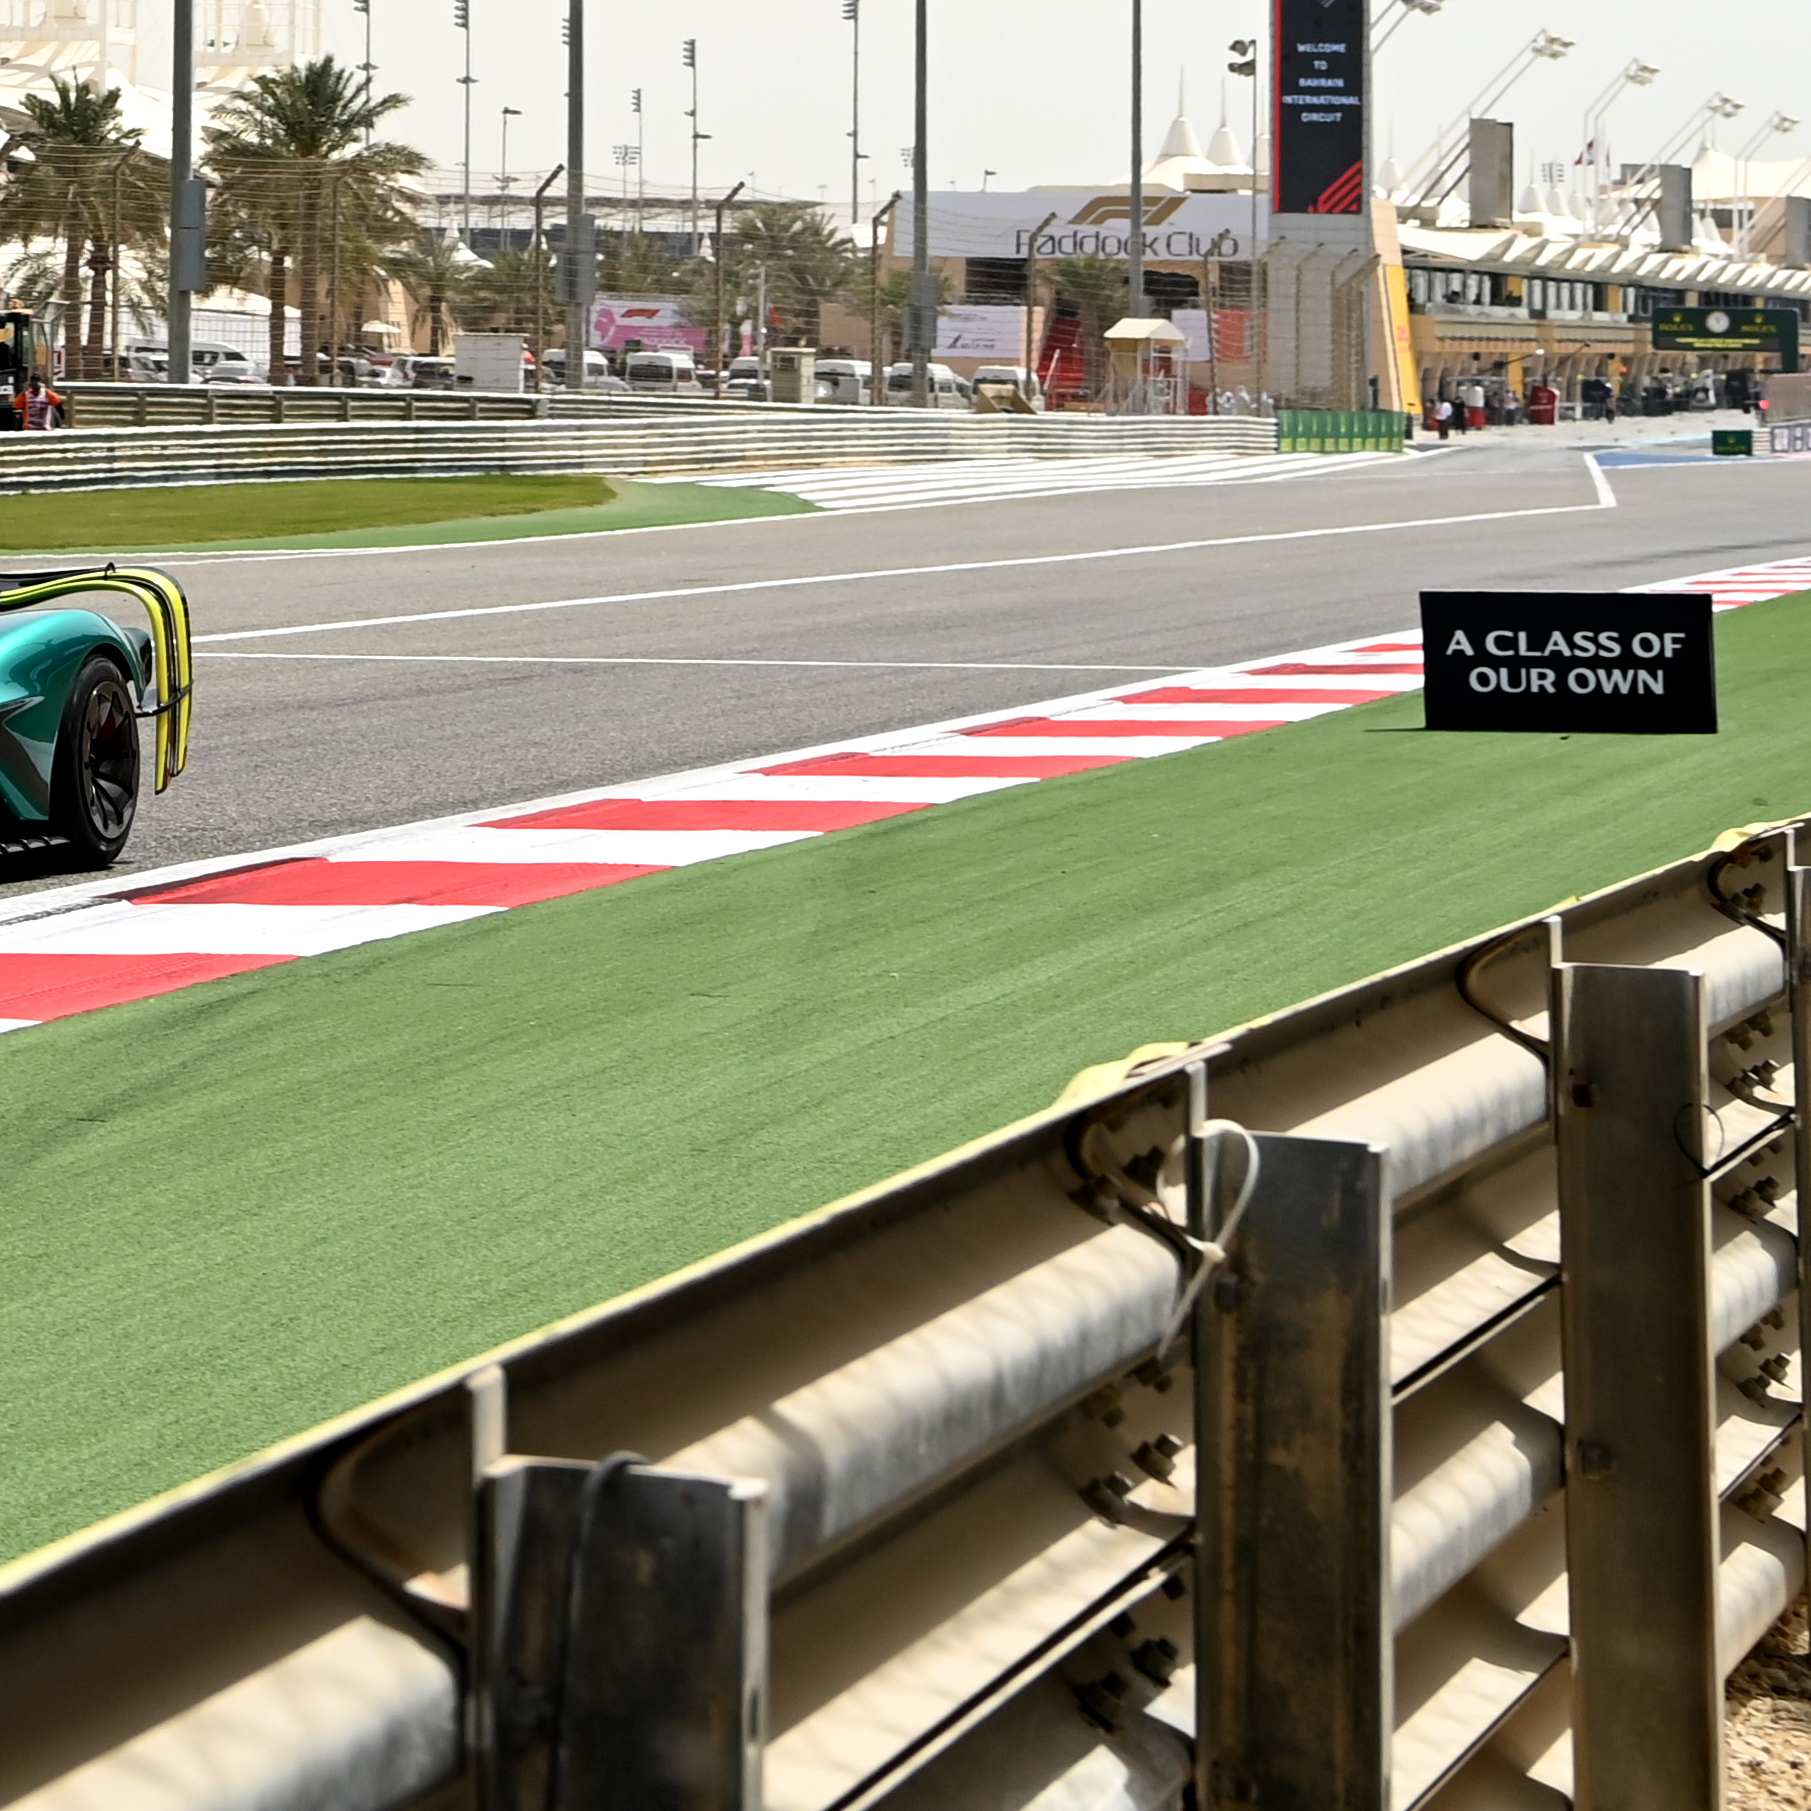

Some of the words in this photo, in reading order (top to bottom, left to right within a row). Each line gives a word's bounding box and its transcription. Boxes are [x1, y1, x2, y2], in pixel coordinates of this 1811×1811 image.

[1296, 42, 1347, 53] WELCOME
[1313, 60, 1328, 71] TO
[1301, 112, 1342, 123] CIRCUIT
[1447, 630, 1473, 655] A
[1486, 631, 1621, 657] CLASS
[1633, 633, 1685, 658] OF
[1470, 667, 1555, 692] OUR
[1568, 668, 1664, 694] OWN
